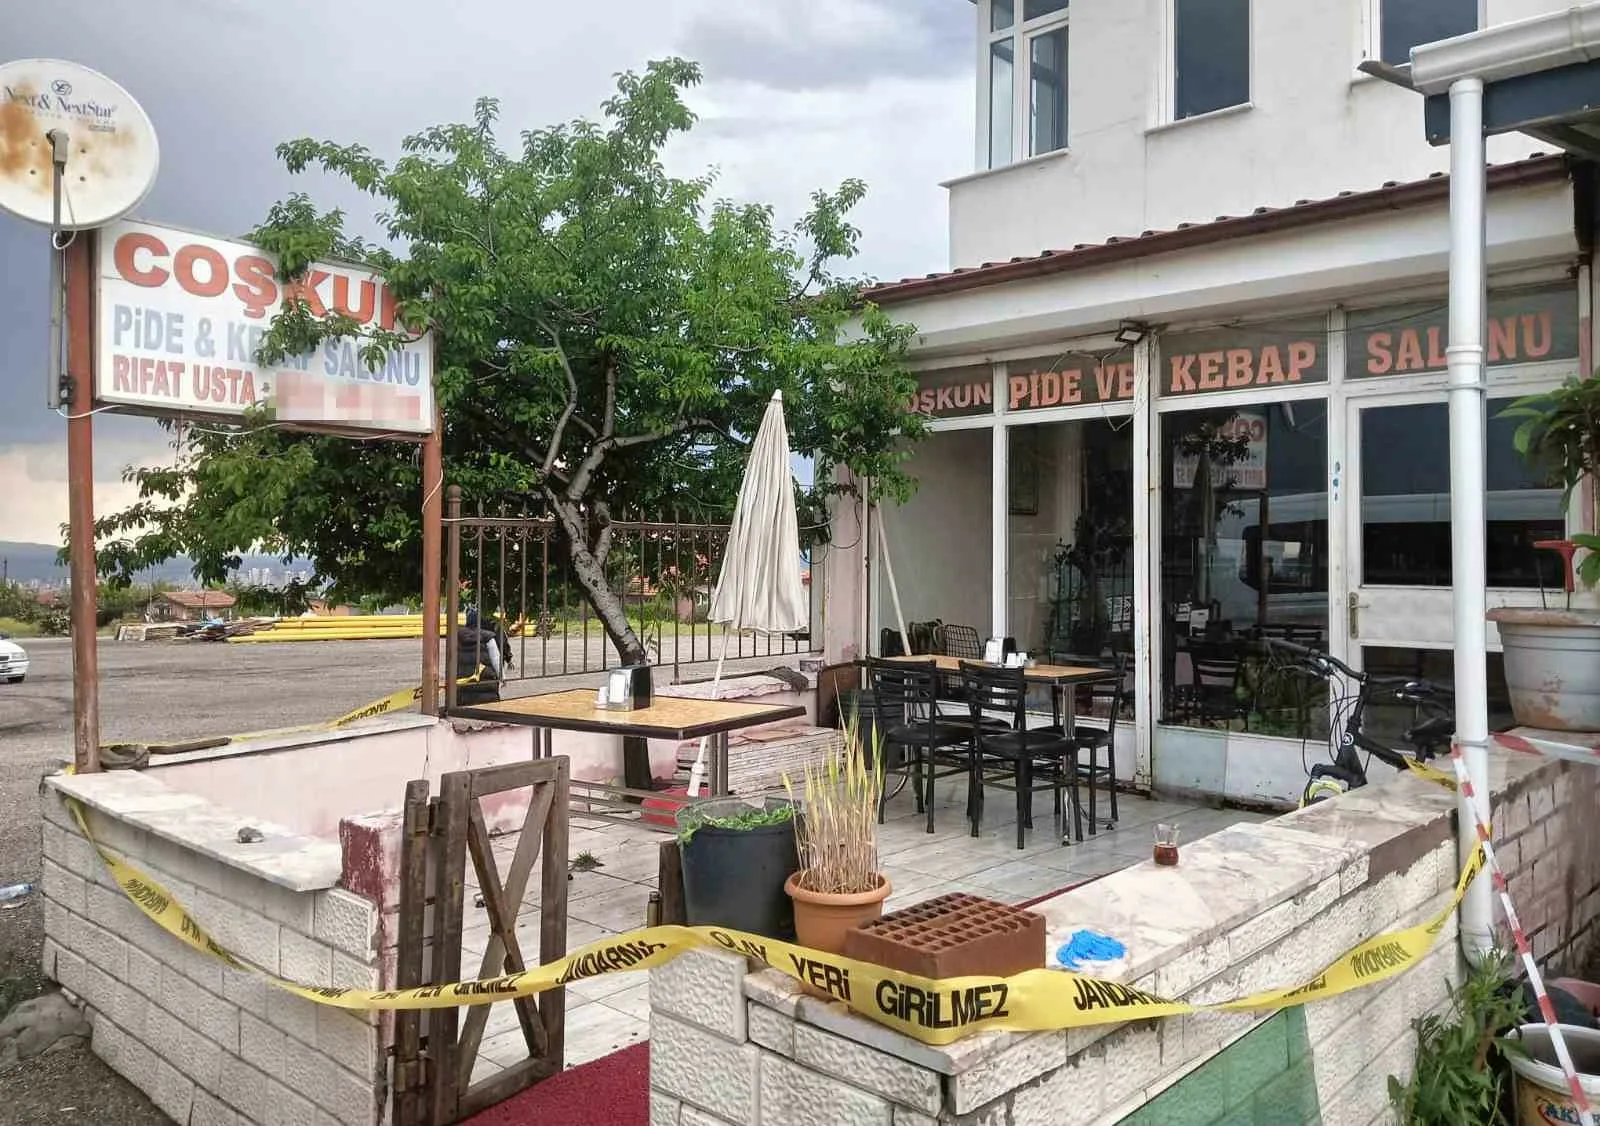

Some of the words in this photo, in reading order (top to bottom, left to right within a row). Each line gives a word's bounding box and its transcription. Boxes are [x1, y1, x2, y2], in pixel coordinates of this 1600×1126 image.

[195, 317, 216, 358] &
[1093, 362, 1134, 401] VE
[1170, 341, 1316, 392] KEBAP
[1367, 312, 1553, 374] SALNU
[112, 354, 186, 398] RIFAT
[193, 364, 257, 404] USTA
[1073, 977, 1172, 1011] JANDA
